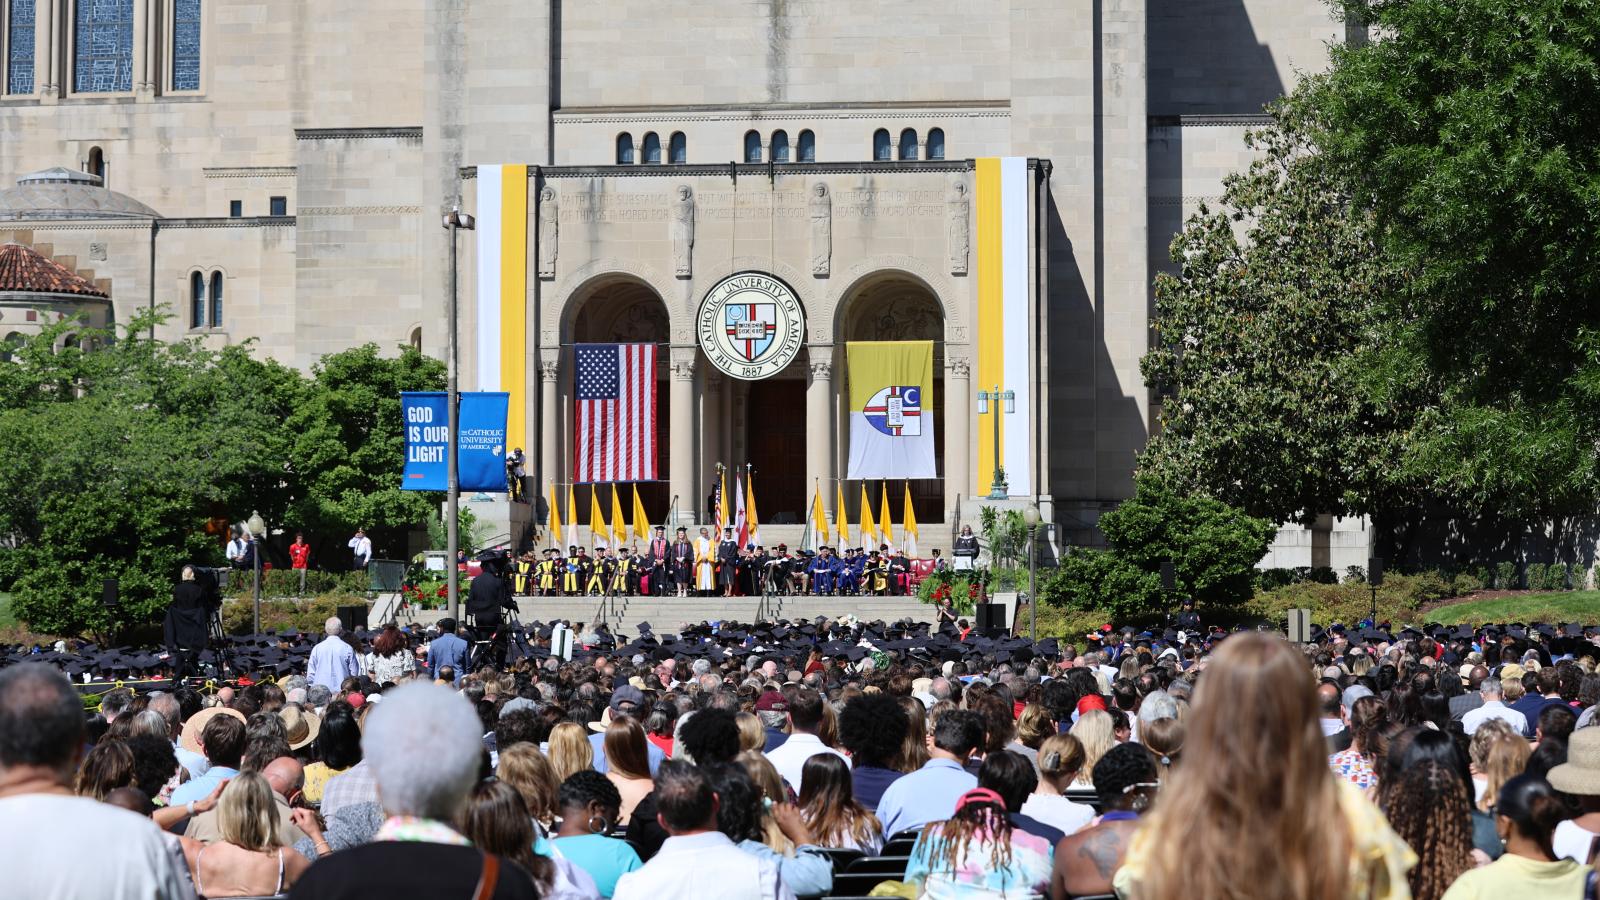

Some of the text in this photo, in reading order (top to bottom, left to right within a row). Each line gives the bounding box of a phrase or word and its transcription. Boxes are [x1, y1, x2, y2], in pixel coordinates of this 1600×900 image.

[723, 278, 787, 299] UNIVERSITY
[784, 299, 795, 313] OF
[702, 295, 721, 352] CATHOLIC
[771, 319, 799, 367] AMERICA
[715, 353, 733, 371] THE
[742, 366, 763, 377] 1887
[408, 406, 433, 423] GOD
[409, 426, 449, 443] IS OUR
[461, 436, 503, 444] UNIVERSITY
[409, 445, 445, 463] LIGHT
